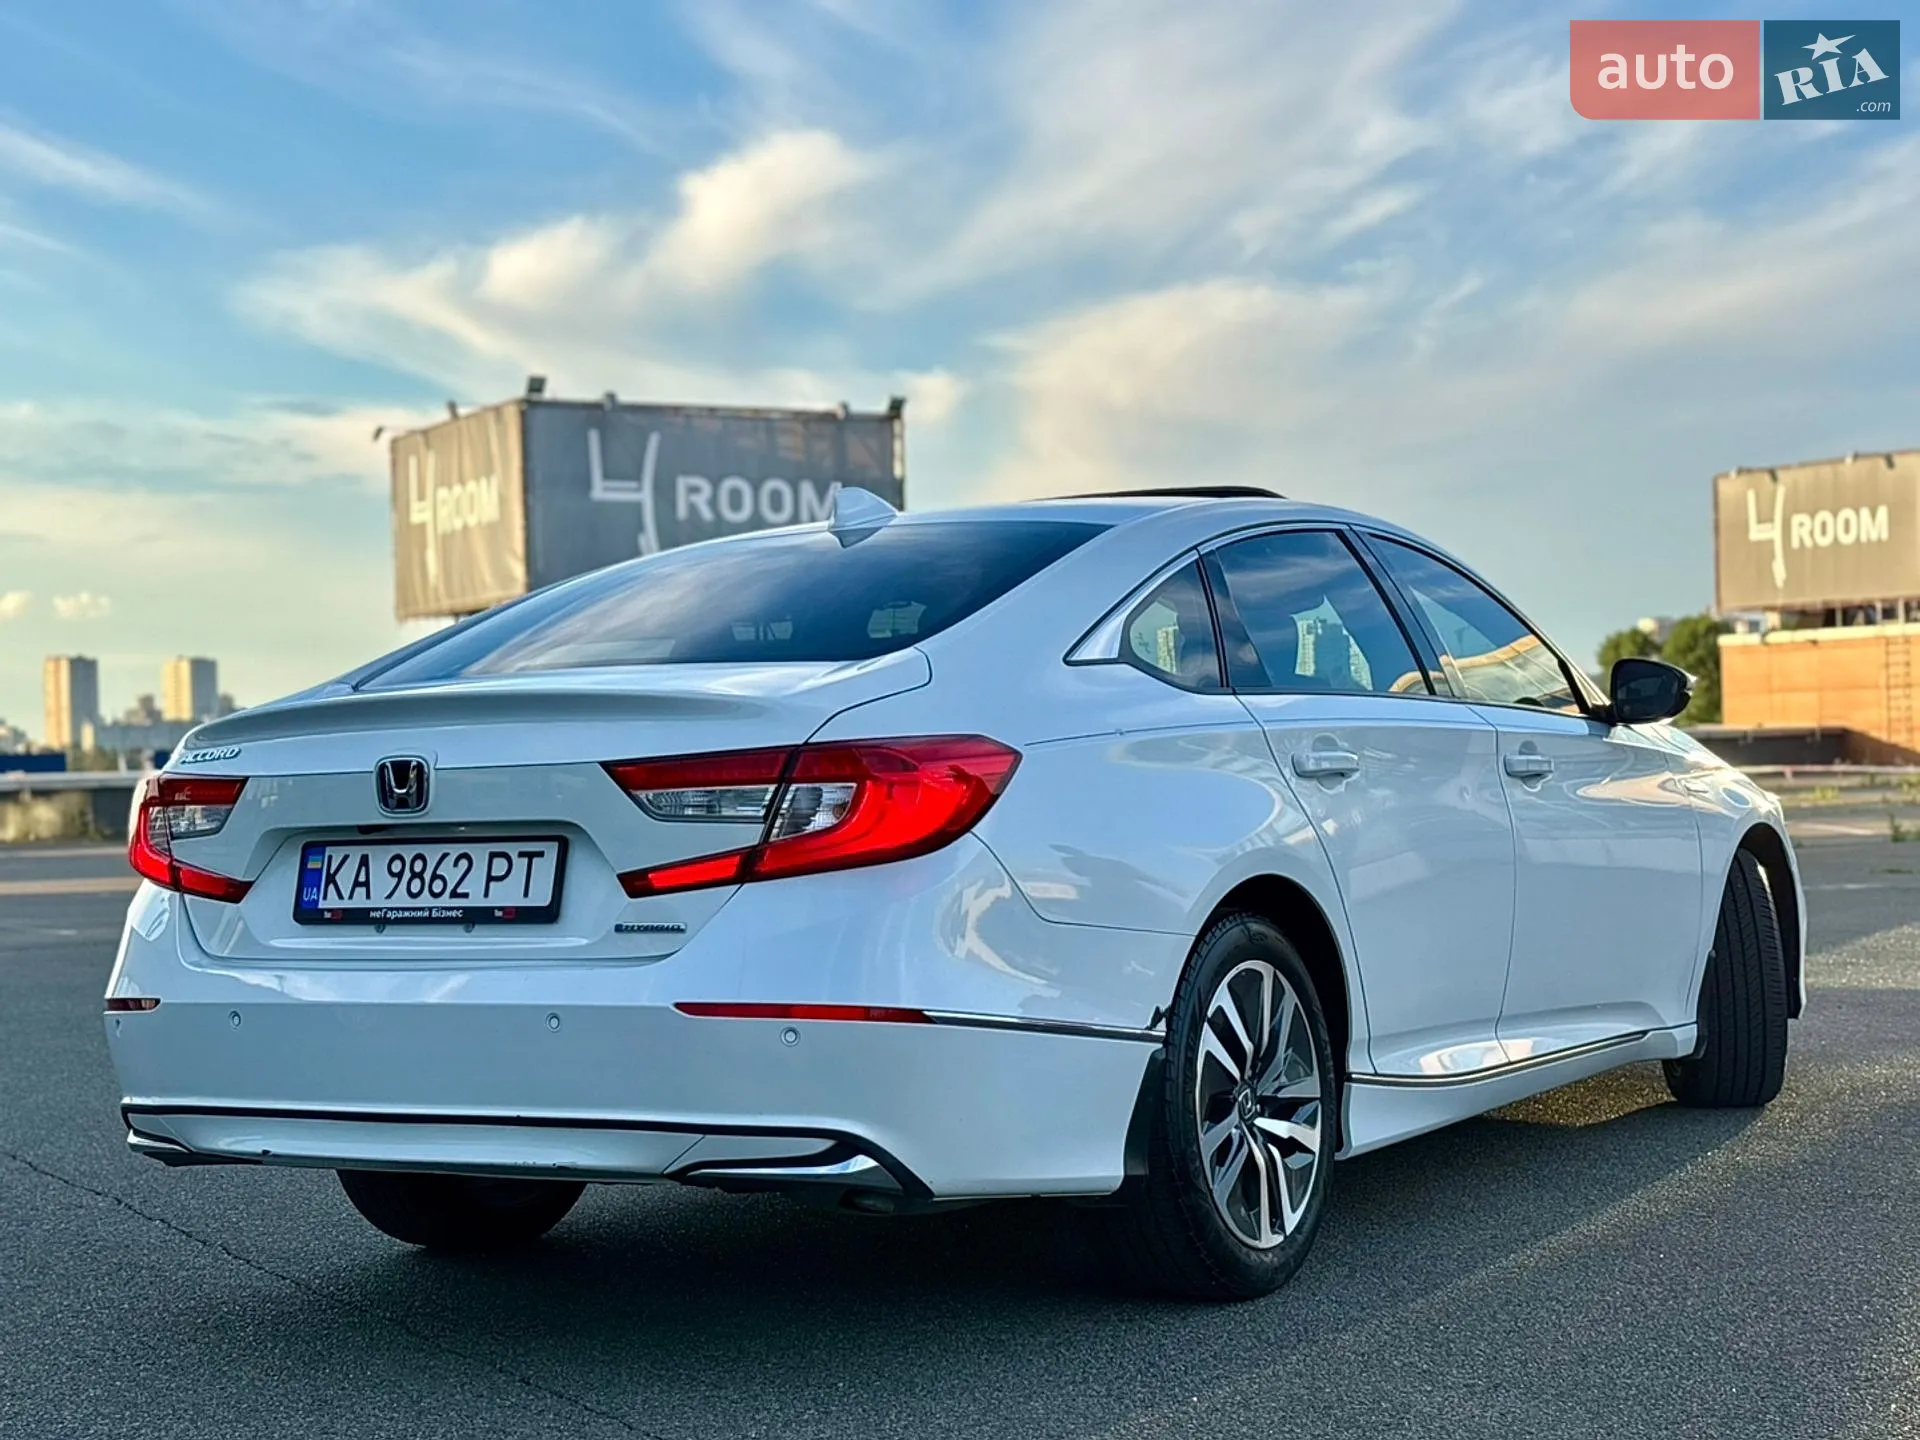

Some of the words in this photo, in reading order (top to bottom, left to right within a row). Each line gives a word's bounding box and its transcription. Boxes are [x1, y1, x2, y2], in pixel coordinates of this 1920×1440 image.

[437, 475, 499, 534] ROOM
[675, 474, 842, 523] ROOM
[1791, 504, 1889, 550] ROOM
[181, 745, 242, 764] ACCORD
[303, 887, 318, 902] UA
[322, 853, 371, 901] KA
[384, 851, 474, 900] 9862
[483, 850, 545, 899] PT
